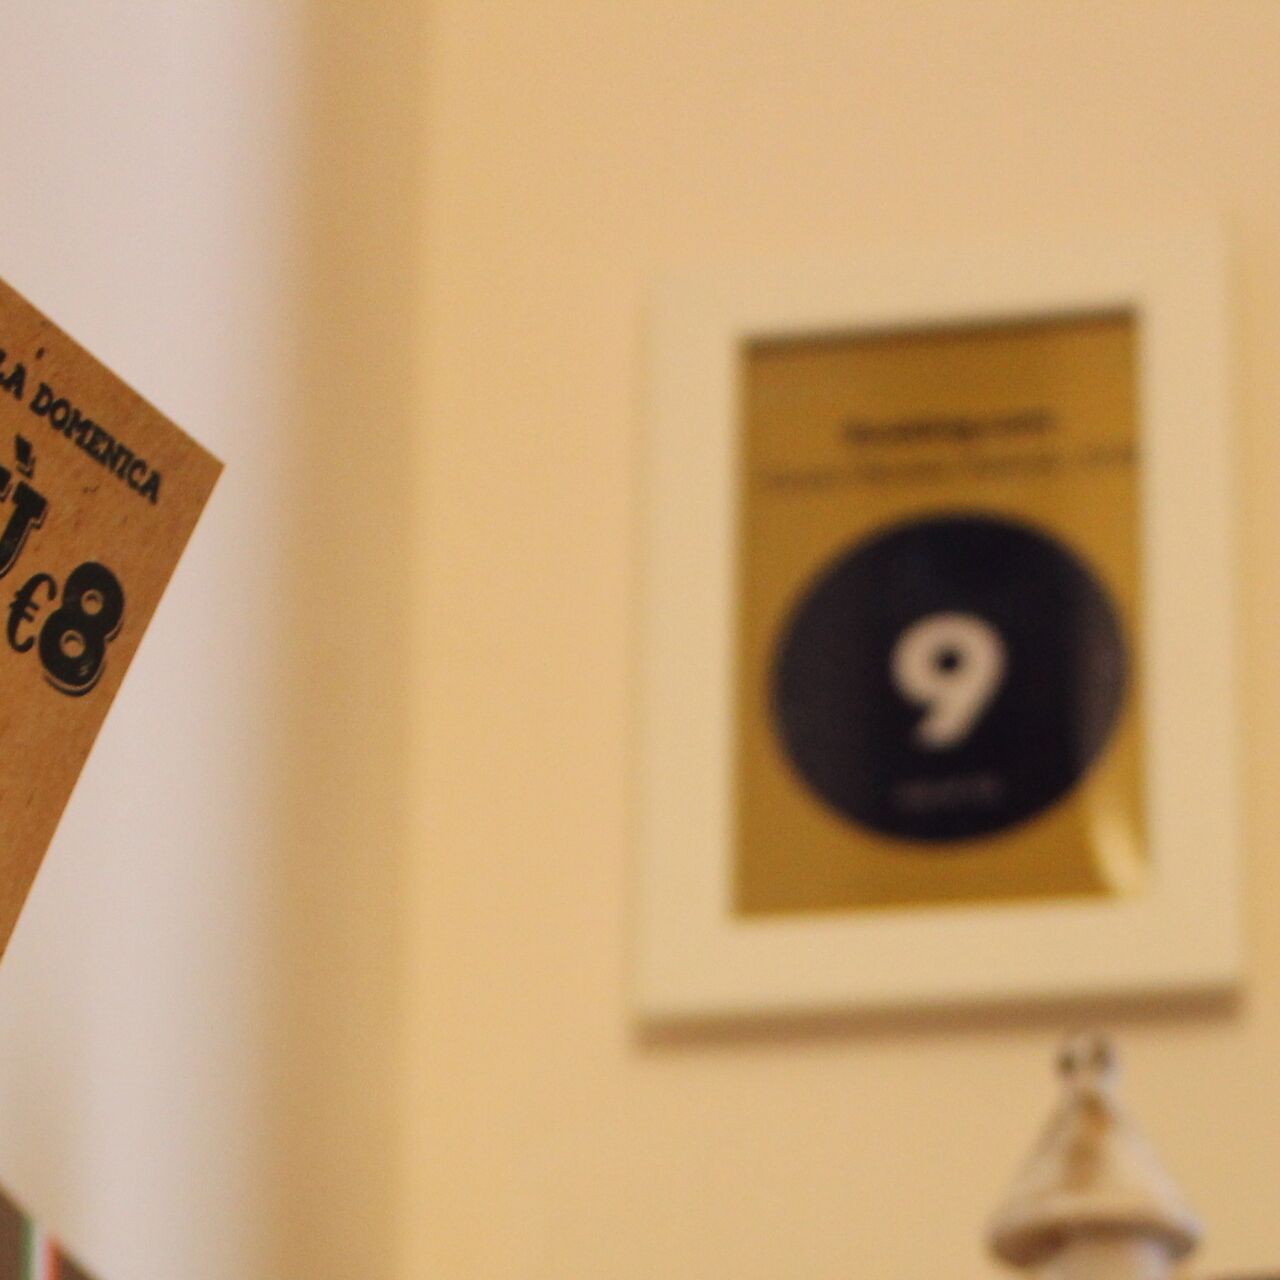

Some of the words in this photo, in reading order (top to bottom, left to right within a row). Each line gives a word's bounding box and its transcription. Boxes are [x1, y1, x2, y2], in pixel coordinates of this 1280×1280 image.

[29, 381, 163, 504] DOMENICA
[6, 561, 125, 697] €8
[890, 607, 1007, 752] 9
